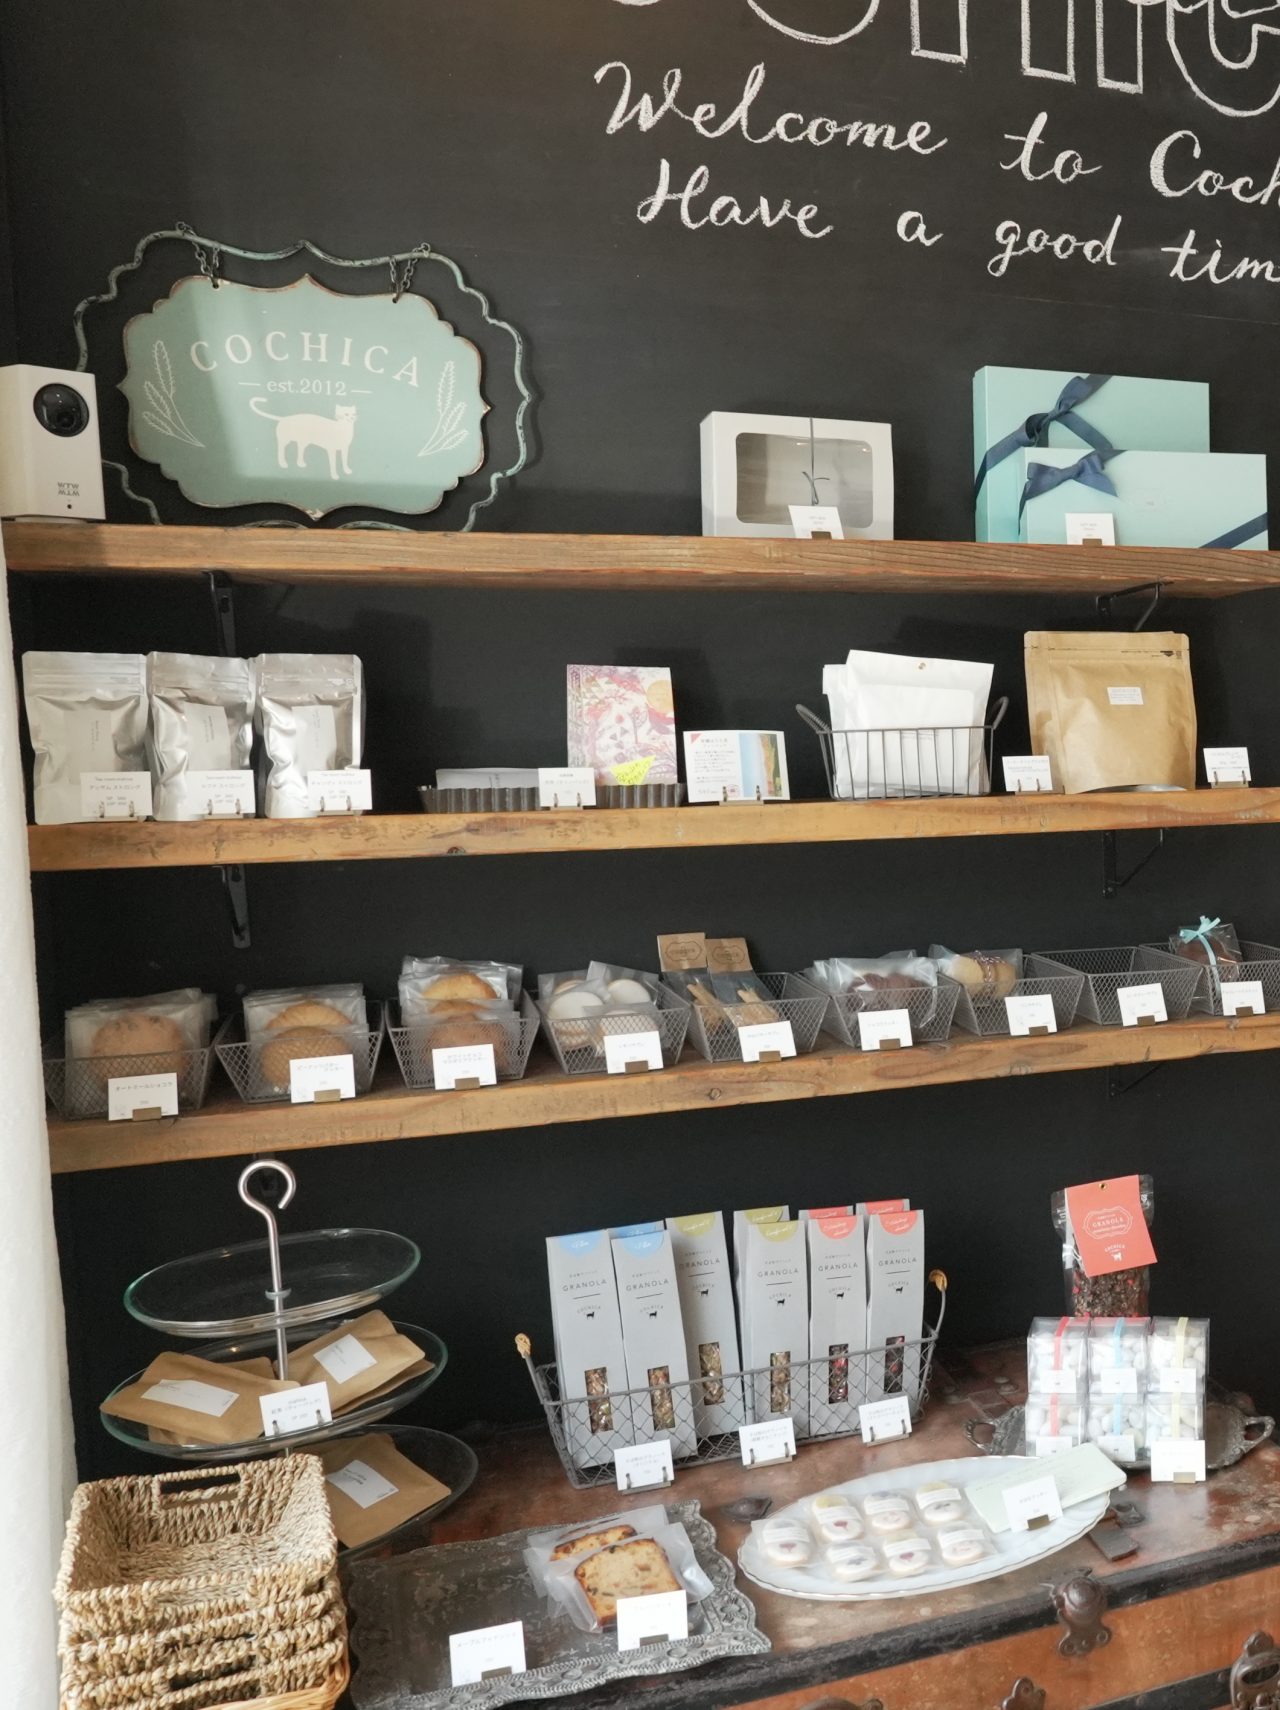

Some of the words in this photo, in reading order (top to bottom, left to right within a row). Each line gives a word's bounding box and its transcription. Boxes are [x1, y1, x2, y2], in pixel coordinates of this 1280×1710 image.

[594, 61, 948, 154] Welcome
[1000, 112, 1101, 183] to
[637, 158, 833, 238] Have
[897, 211, 943, 246] a
[987, 215, 1121, 276] good
[190, 330, 420, 388] COCHICA
[266, 377, 348, 396] est.2012
[1092, 1217, 1124, 1228] GRANOLA
[679, 1258, 721, 1270] GRANOLA
[818, 1262, 859, 1272] GRANOLA
[878, 1256, 918, 1267] GRANOLA
[757, 1267, 800, 1278] GRANOLA
[562, 1278, 608, 1292] GRANOLA
[625, 1278, 670, 1292] GRANOLA
